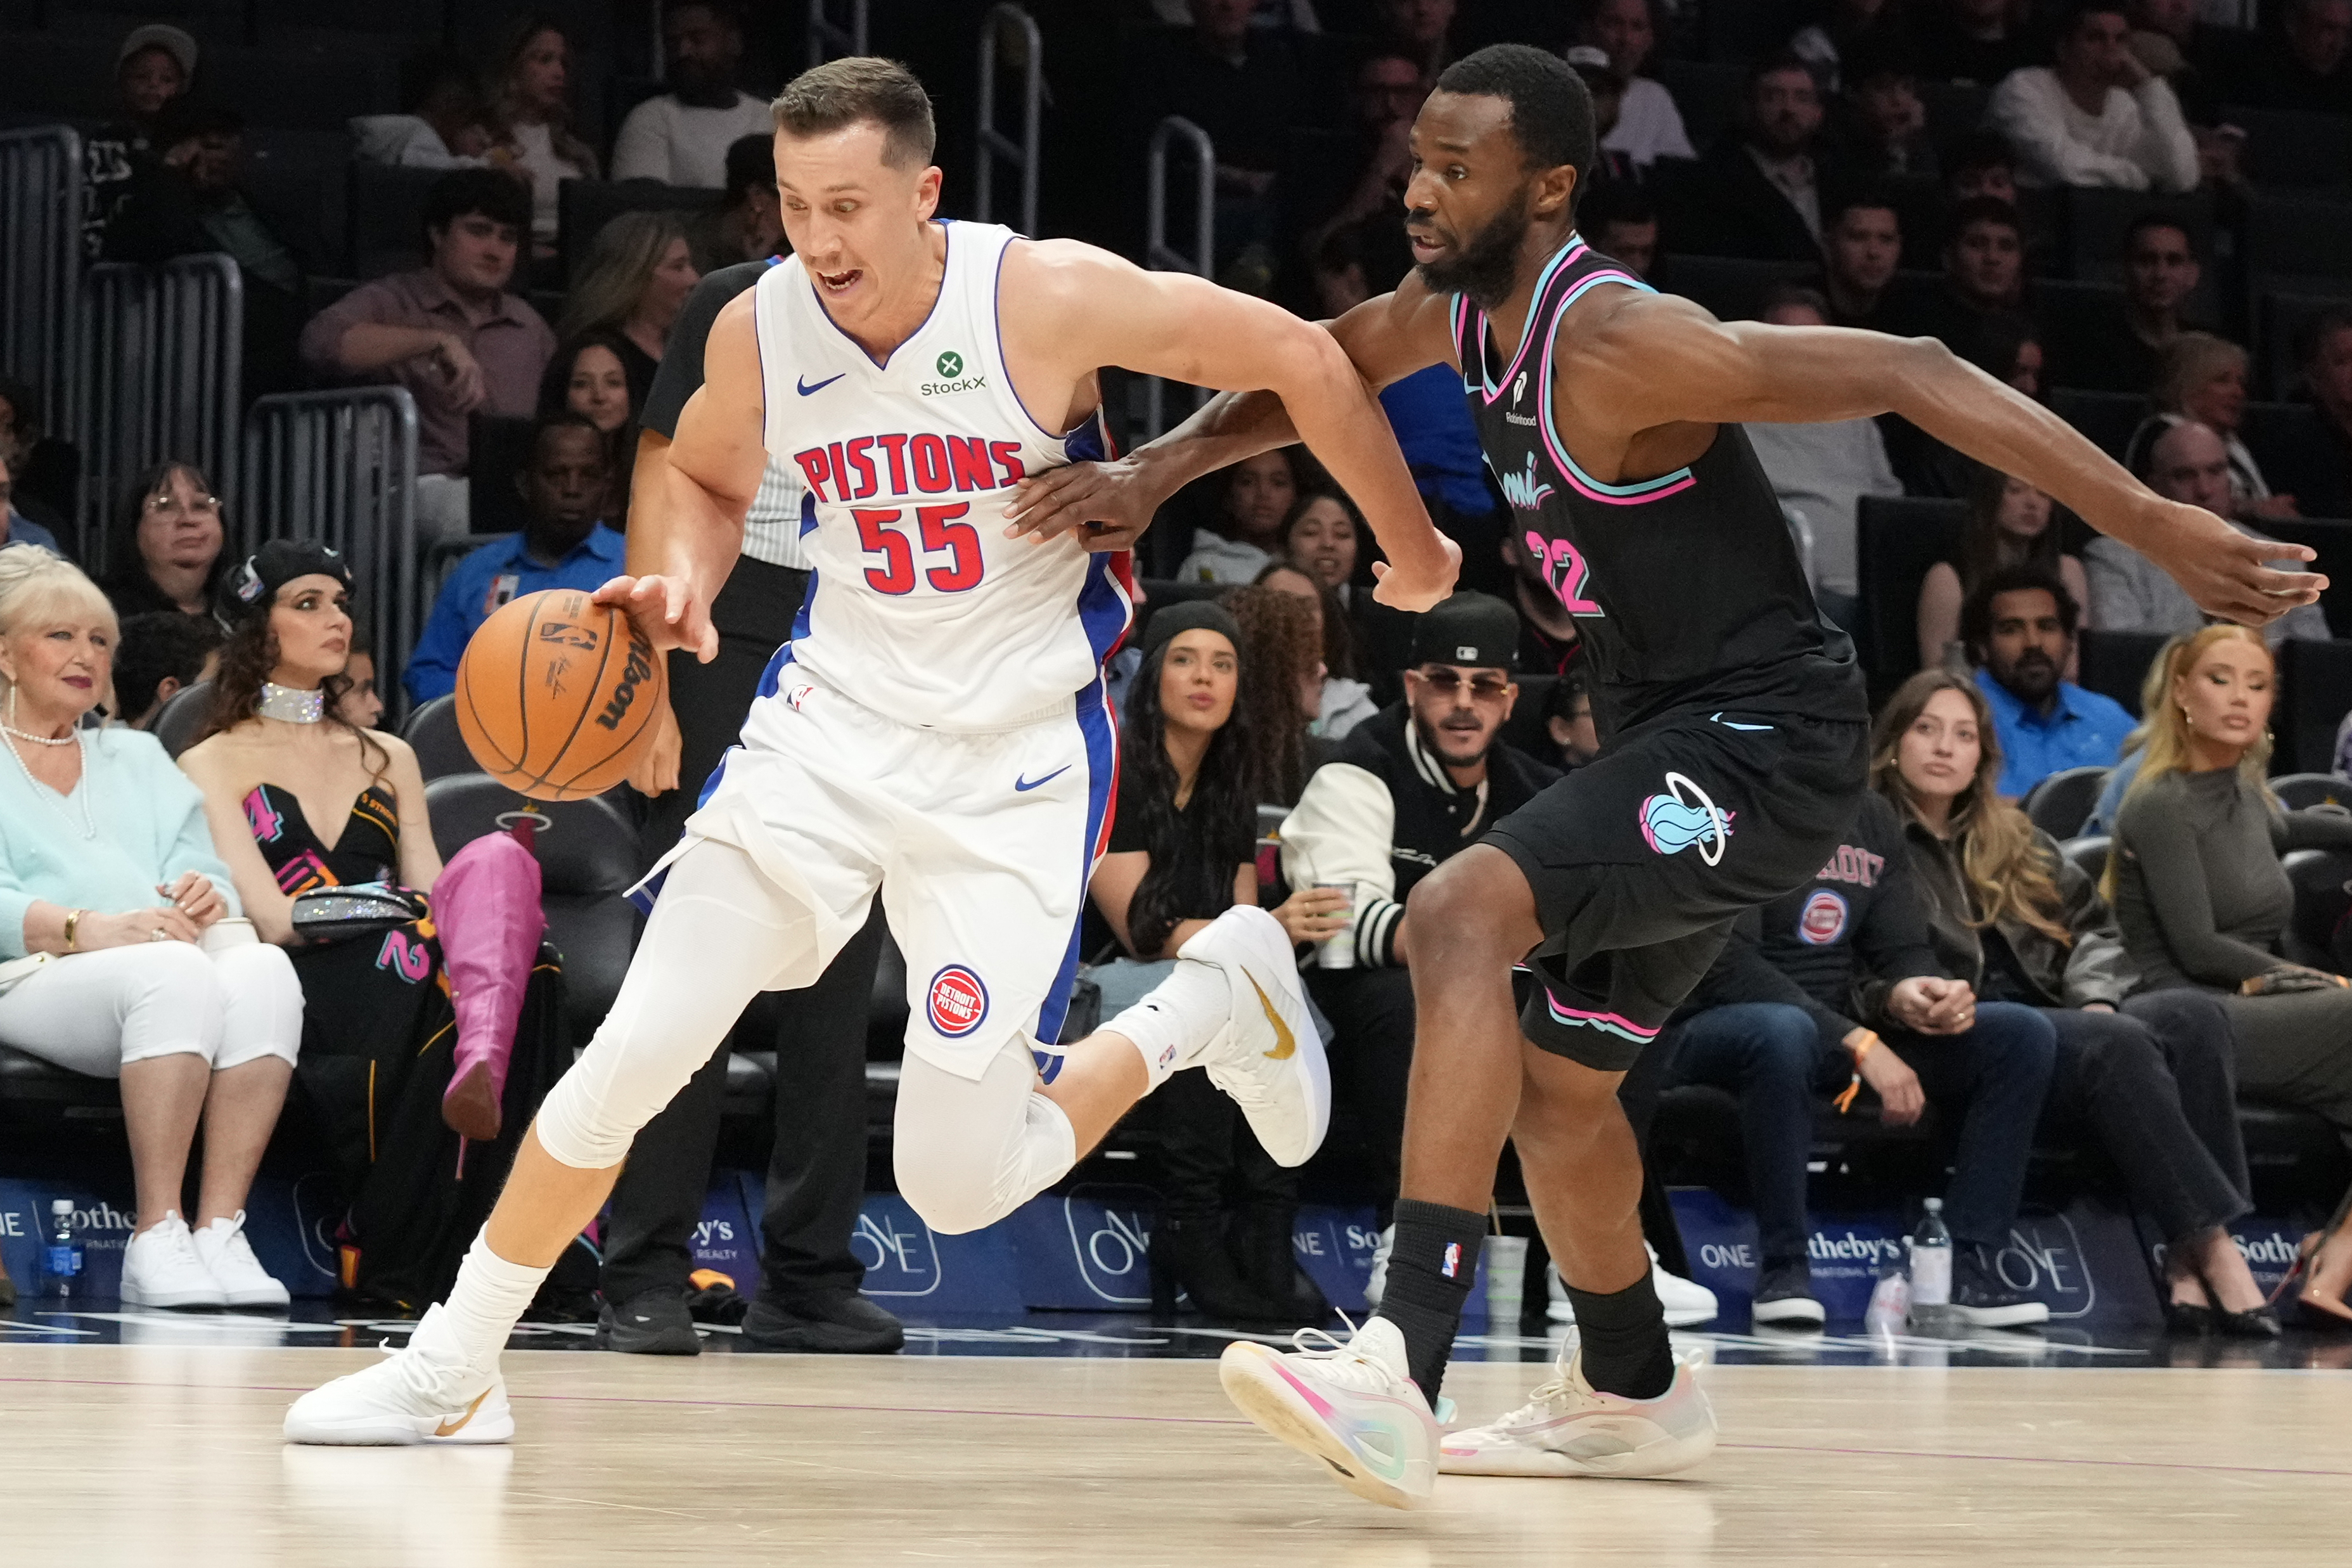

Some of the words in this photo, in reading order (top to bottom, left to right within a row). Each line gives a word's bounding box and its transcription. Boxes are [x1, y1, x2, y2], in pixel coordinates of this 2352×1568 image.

[921, 375, 987, 396] StockX
[794, 433, 1026, 503] PISTONS
[849, 501, 985, 596] 55
[1526, 530, 1605, 617] 22
[936, 993, 974, 1020] PISTONS
[941, 982, 977, 1008] DETROIT
[1700, 1243, 1756, 1268] ONE
[1806, 1231, 1901, 1265] theby's
[1996, 1228, 2079, 1292] ONE
